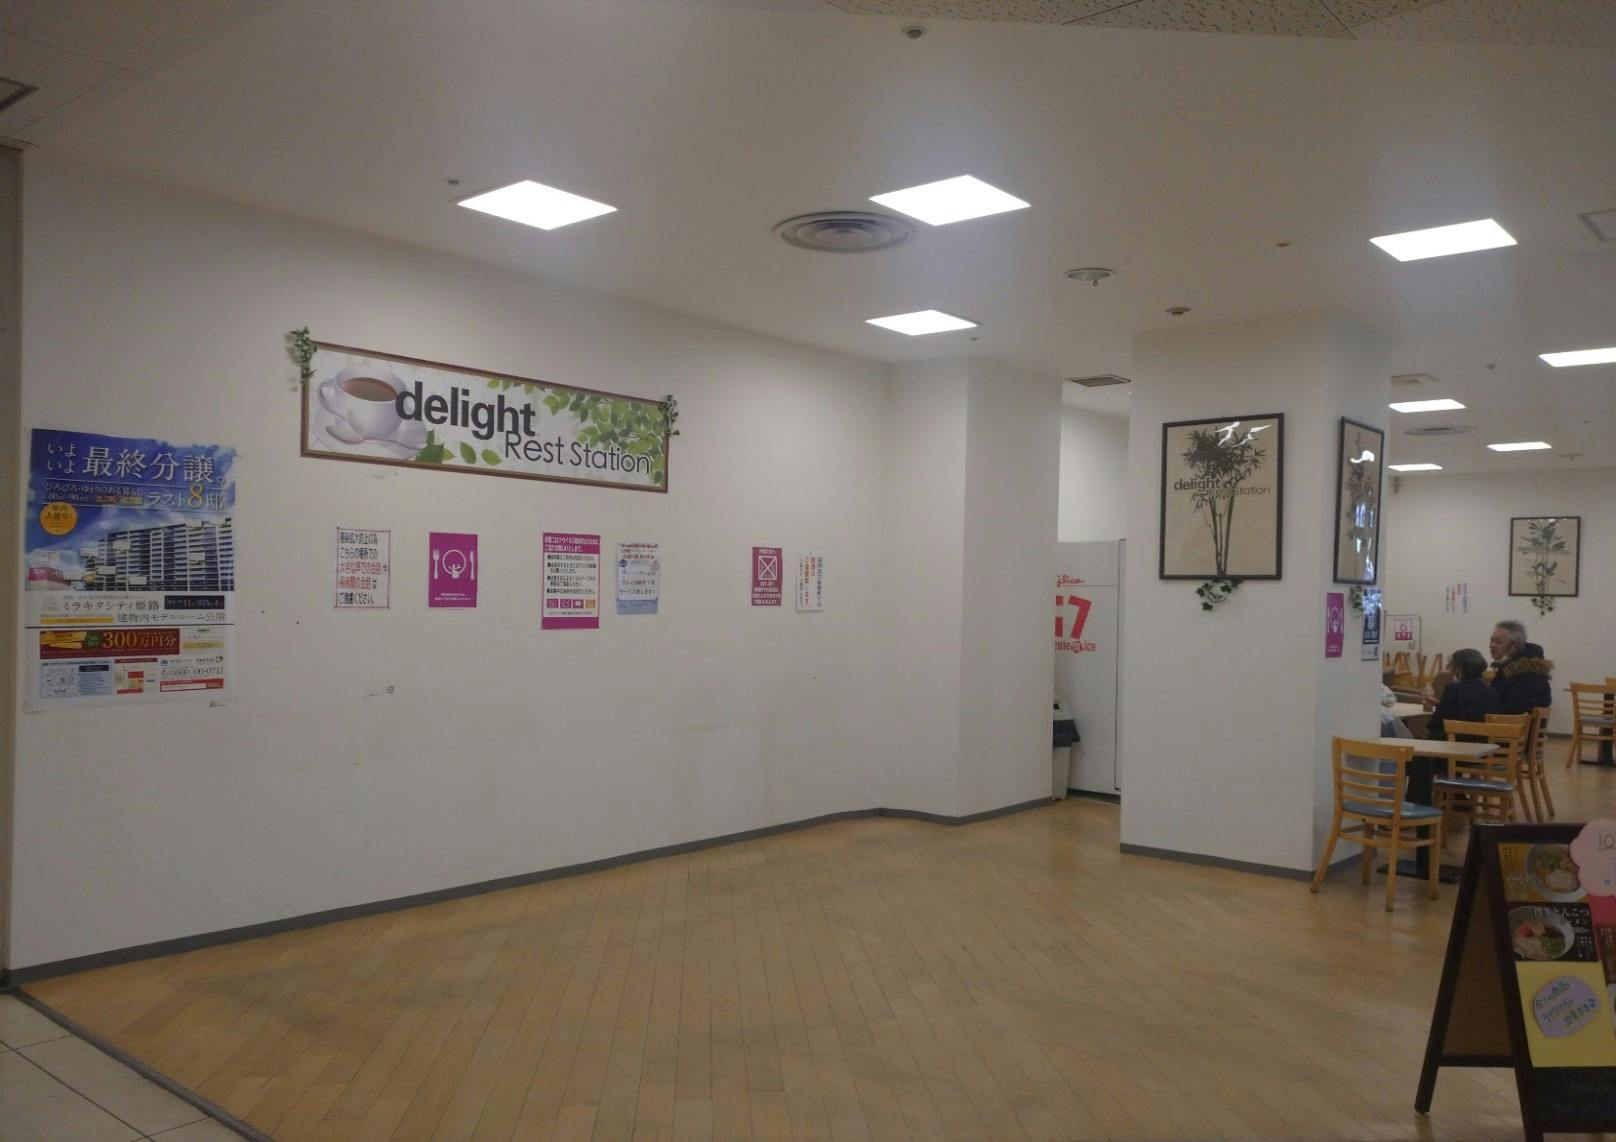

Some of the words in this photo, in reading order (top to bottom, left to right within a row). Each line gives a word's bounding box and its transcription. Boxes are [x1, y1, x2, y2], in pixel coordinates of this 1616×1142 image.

[395, 381, 536, 440] delight
[506, 430, 564, 465] Rest
[570, 444, 651, 474] Station
[1174, 478, 1221, 492] delight
